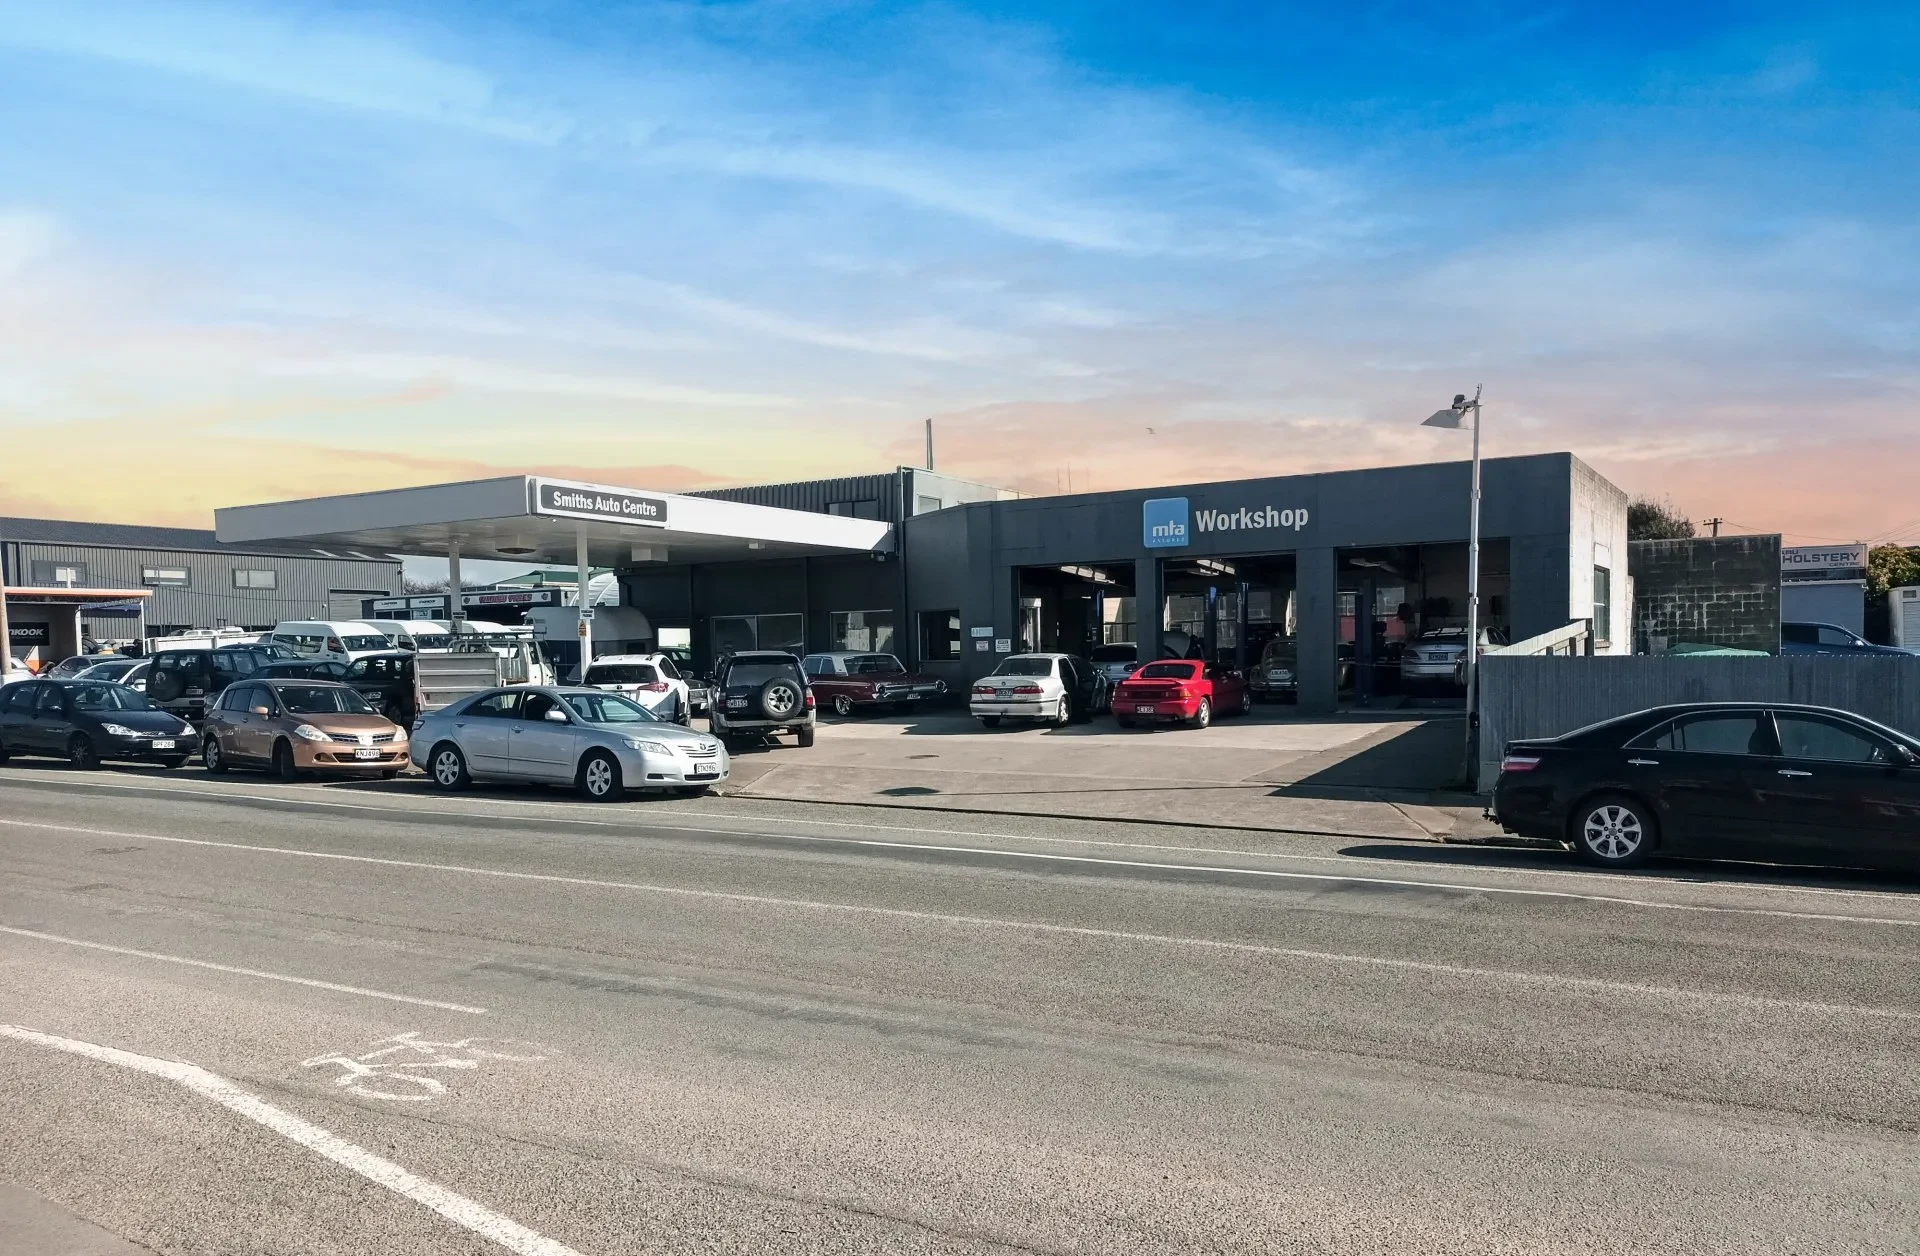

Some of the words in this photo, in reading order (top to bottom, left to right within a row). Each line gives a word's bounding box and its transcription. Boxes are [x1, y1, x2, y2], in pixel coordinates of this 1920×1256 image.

[553, 491, 593, 510] Smiths
[595, 496, 620, 513] Auto
[622, 499, 657, 516] Centre
[1152, 520, 1185, 537] mta
[1195, 505, 1309, 533] Workshop
